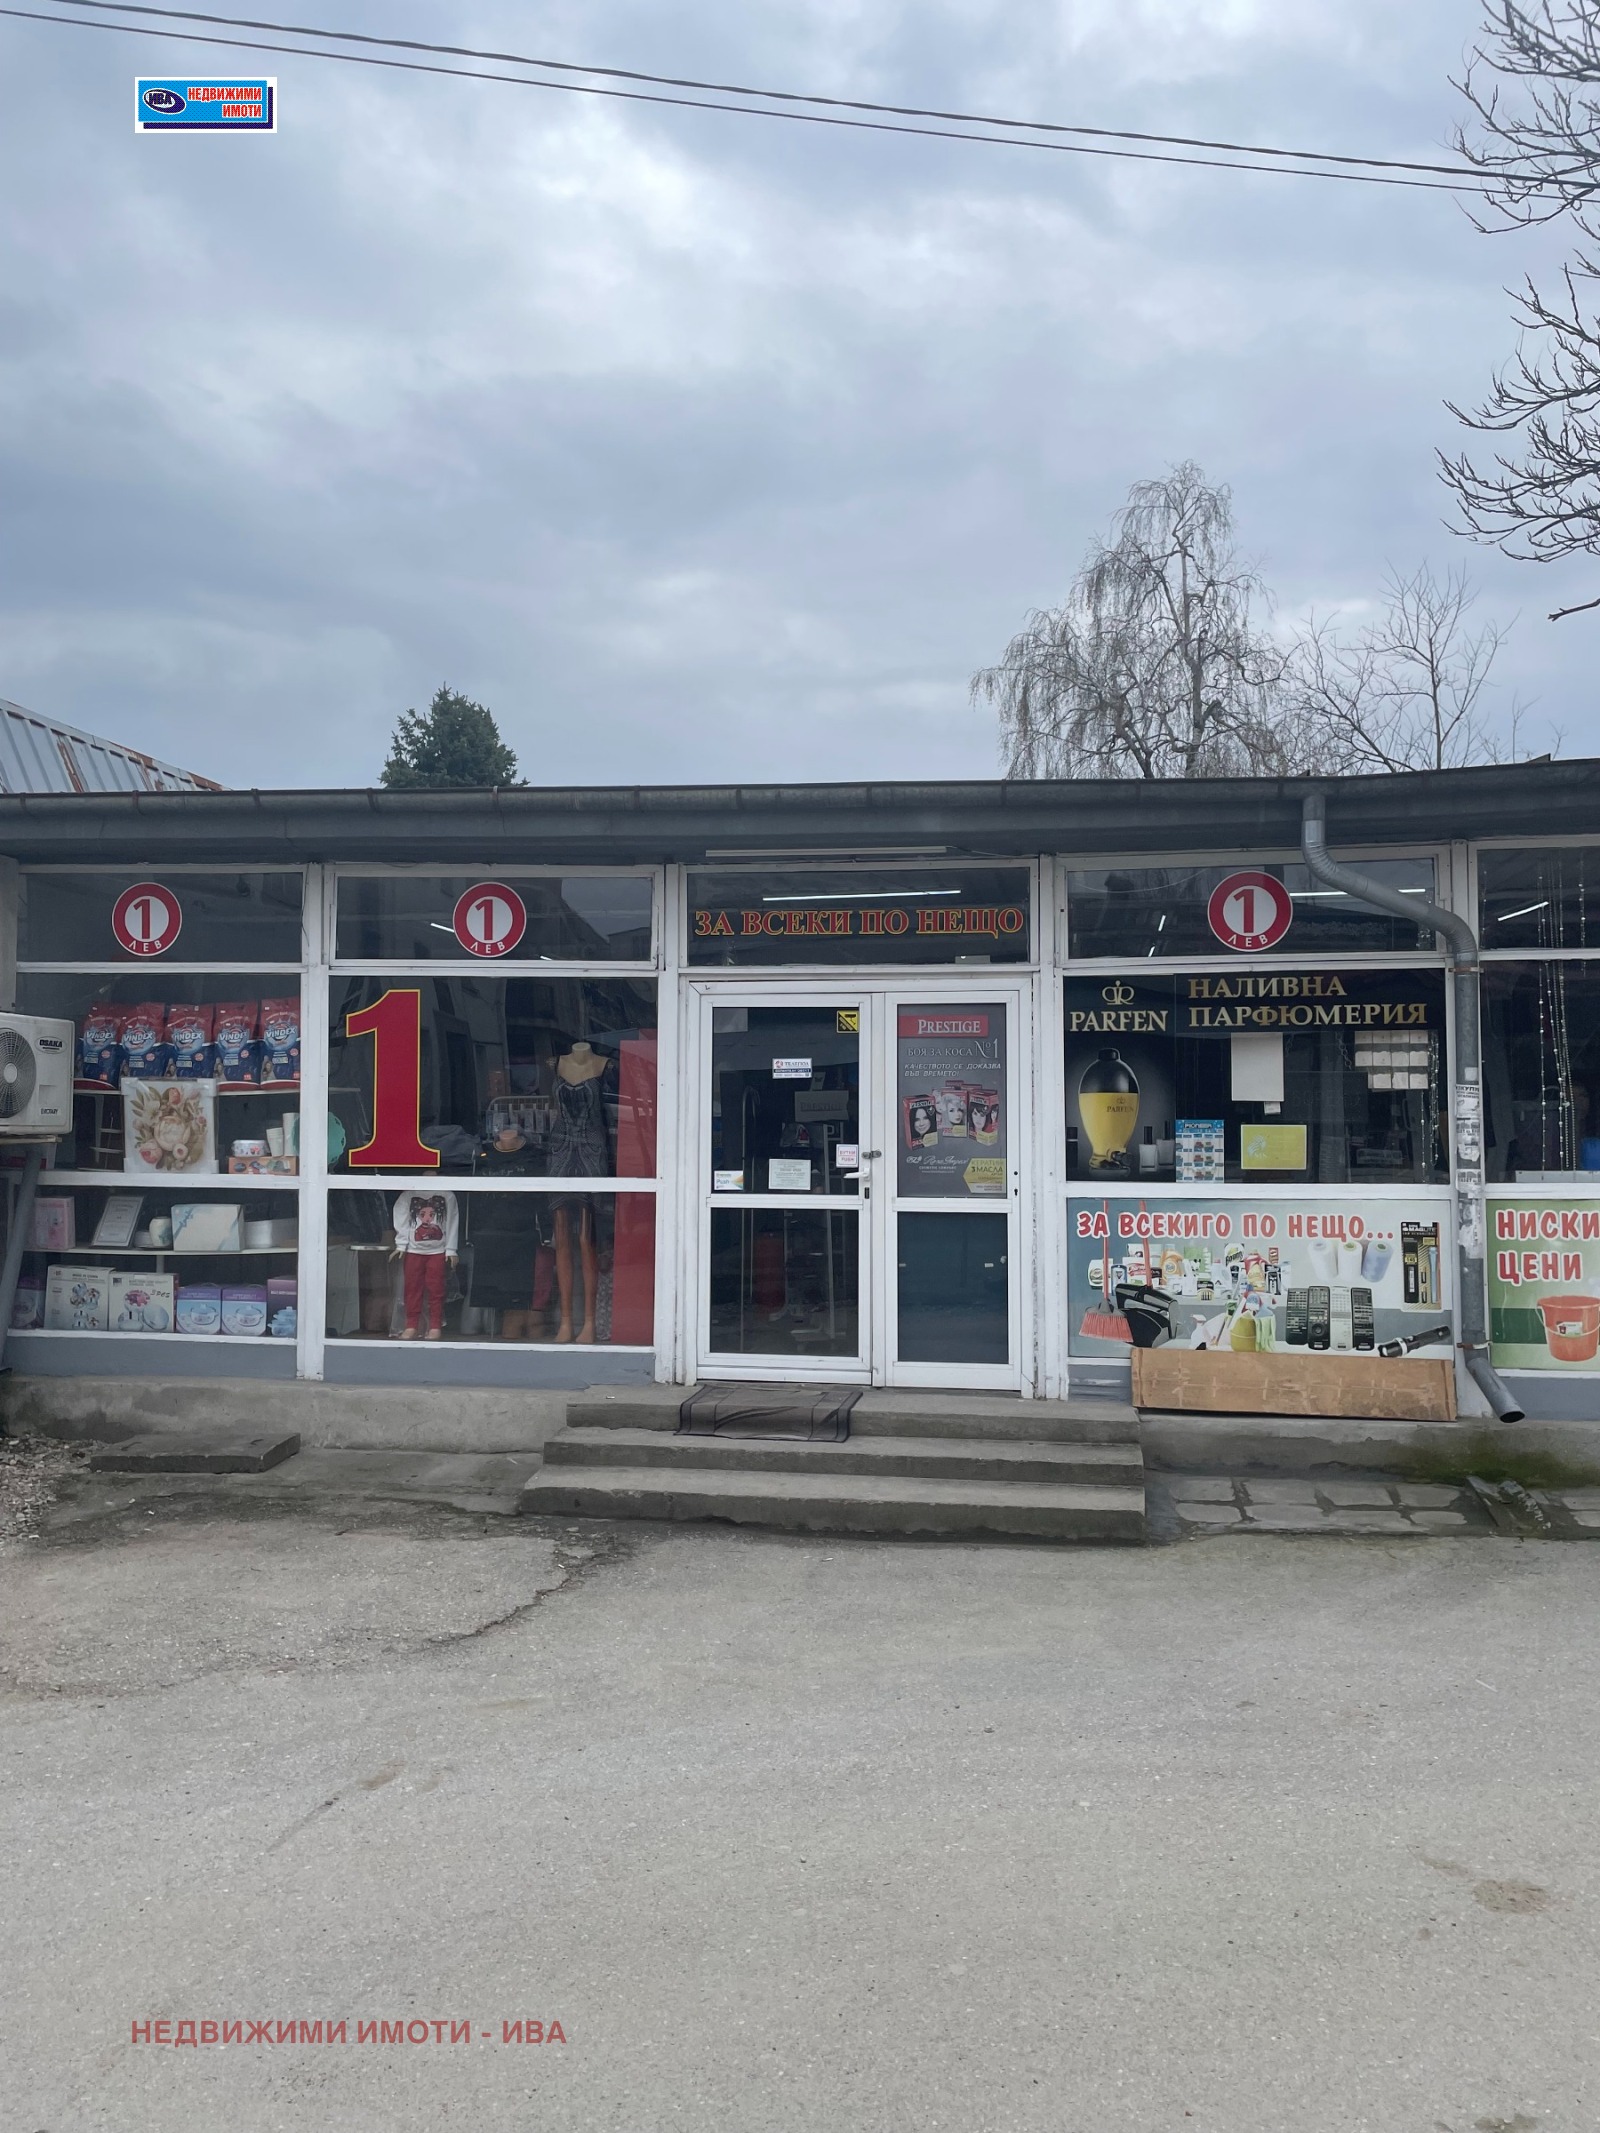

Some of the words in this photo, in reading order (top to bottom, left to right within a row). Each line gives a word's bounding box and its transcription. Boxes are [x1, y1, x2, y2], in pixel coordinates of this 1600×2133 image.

[133, 898, 150, 940] 1
[475, 899, 493, 941] 1
[1233, 888, 1255, 934] 1
[694, 910, 734, 936] ЗА
[740, 910, 853, 936] ВСЕКИ
[859, 909, 909, 935] ПО
[915, 907, 1024, 940] НЕЩО
[128, 940, 162, 952] ЛЕВ
[470, 941, 506, 954] ЛЕВ
[1228, 934, 1268, 947] ЛЕВ
[1187, 975, 1348, 999] НАЛИВНА
[917, 1019, 982, 1035] PRESTIGE
[1069, 1009, 1169, 1033] PARFEN
[1188, 1002, 1428, 1028] ПАРФЮМЕРИЯ
[39, 1039, 63, 1048] OSAKA
[86, 1031, 115, 1040] VINDEX
[124, 1032, 153, 1042] VINDEX
[266, 1027, 296, 1038] VINDEX
[907, 1047, 927, 1057] БОЯ
[930, 1047, 942, 1057] ЗА
[945, 1047, 973, 1057] КОСА
[345, 988, 442, 1169] 1
[1078, 1213, 1107, 1236] ЗА
[1119, 1213, 1231, 1237] ВСЕКИГО
[1243, 1214, 1277, 1238] ПО
[1288, 1214, 1394, 1242] НЕЩО...
[1497, 1211, 1600, 1240] НИСКИ
[1499, 1252, 1582, 1285] ЦЕНИ
